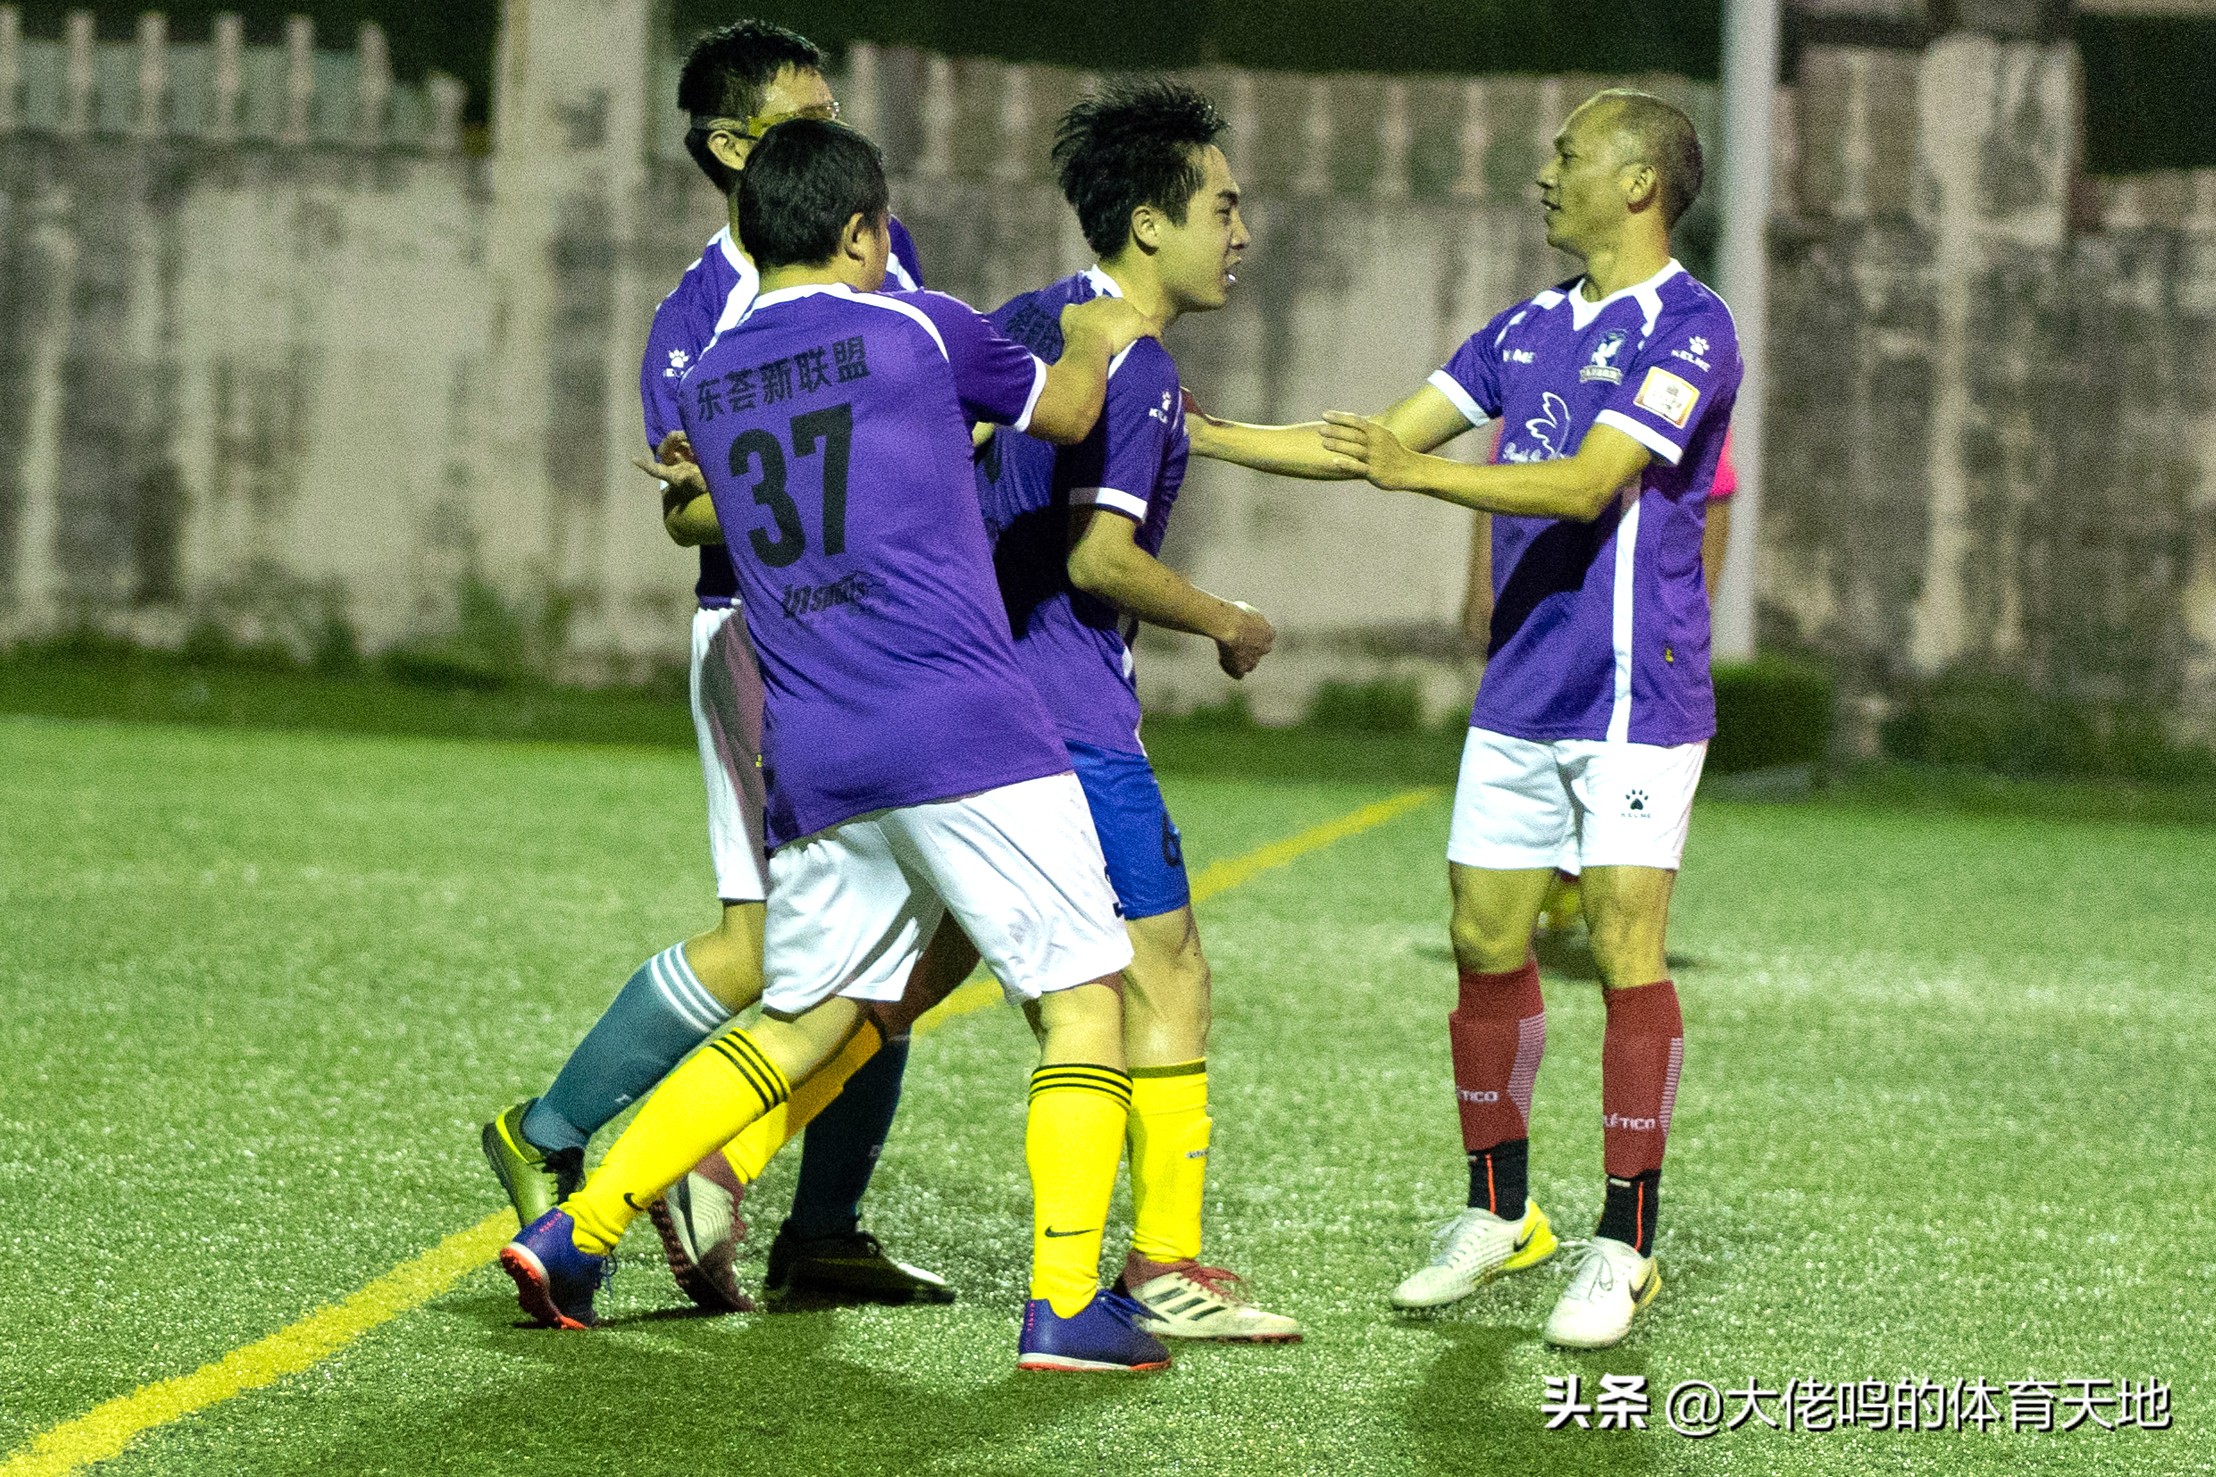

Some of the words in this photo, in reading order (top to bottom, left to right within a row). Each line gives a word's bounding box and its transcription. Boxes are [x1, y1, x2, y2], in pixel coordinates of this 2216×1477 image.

[696, 336, 871, 423] 东荟新联盟
[728, 403, 853, 567] 37
